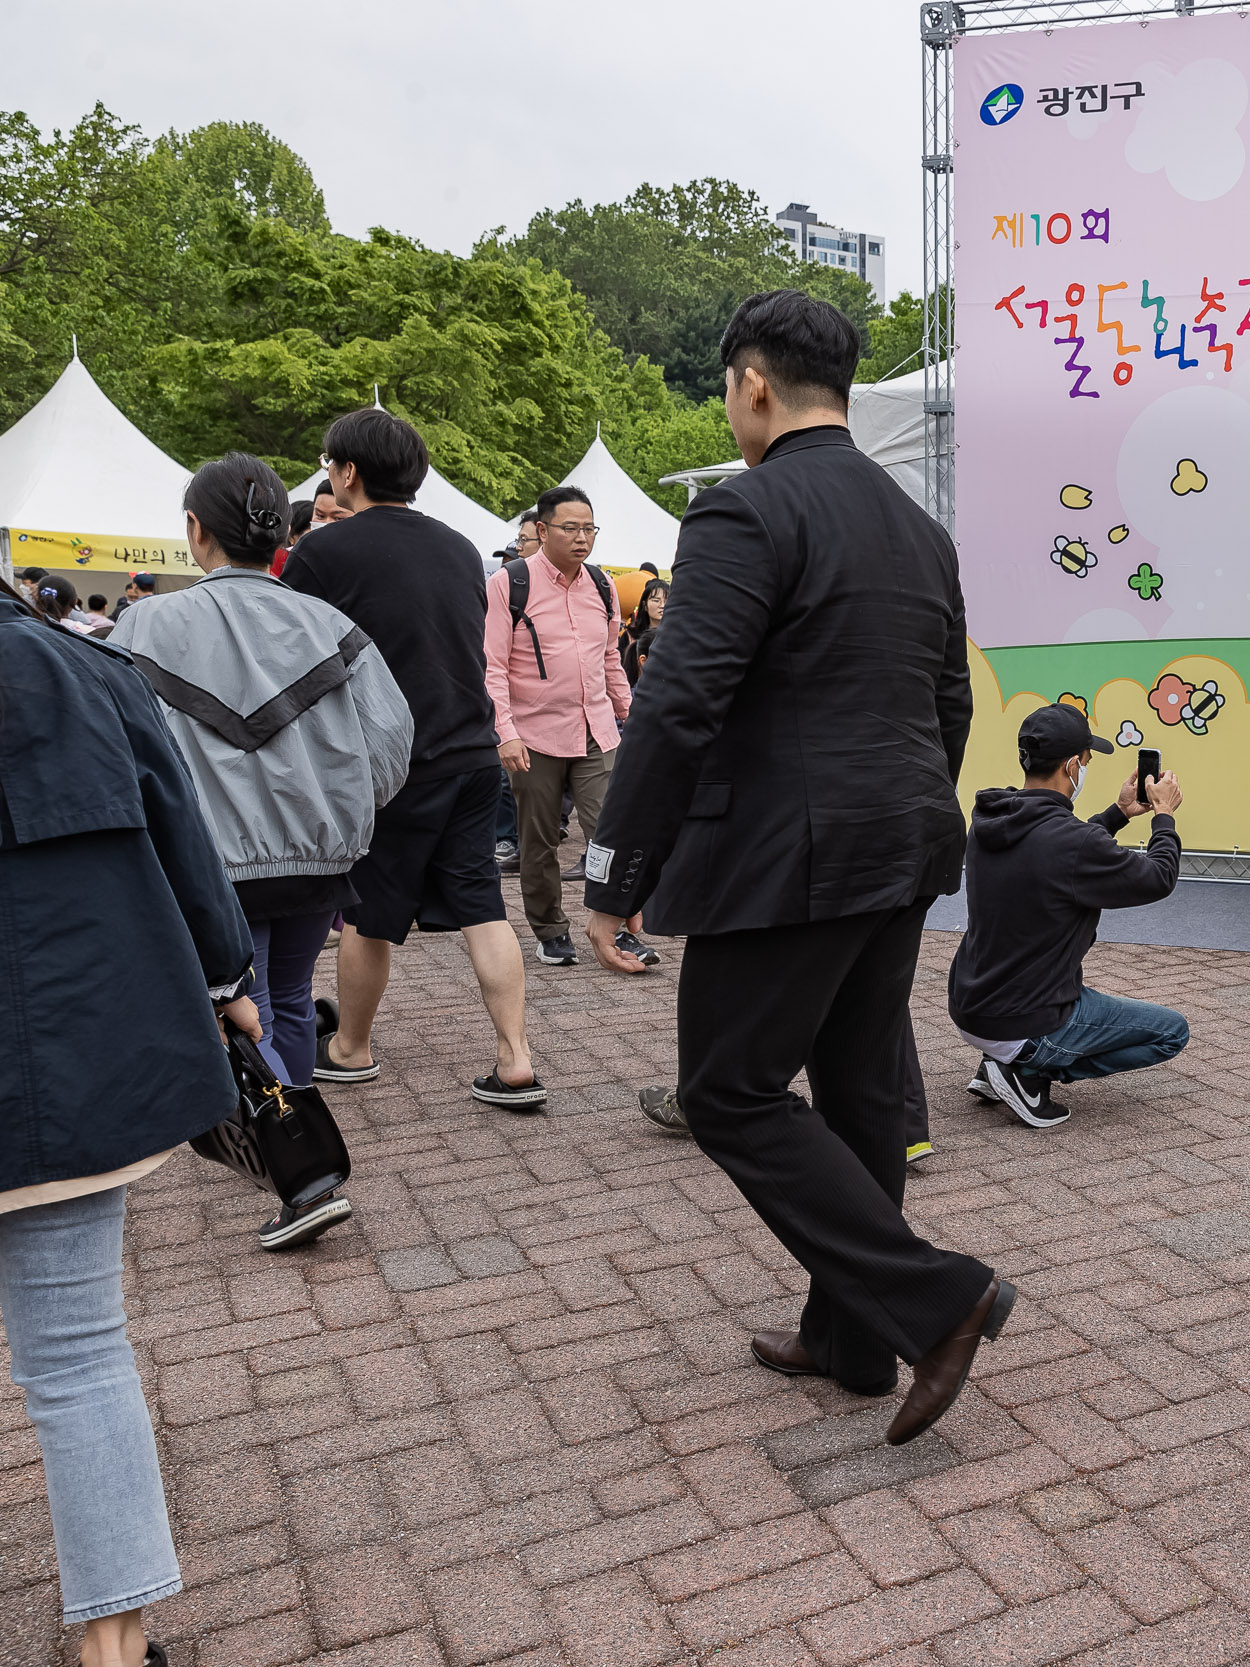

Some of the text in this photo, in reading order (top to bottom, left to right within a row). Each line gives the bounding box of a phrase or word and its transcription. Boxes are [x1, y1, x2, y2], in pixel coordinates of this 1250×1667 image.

[1036, 81, 1146, 117] 광진구
[992, 208, 1110, 248] 제10회
[114, 547, 200, 567] 나만의 책
